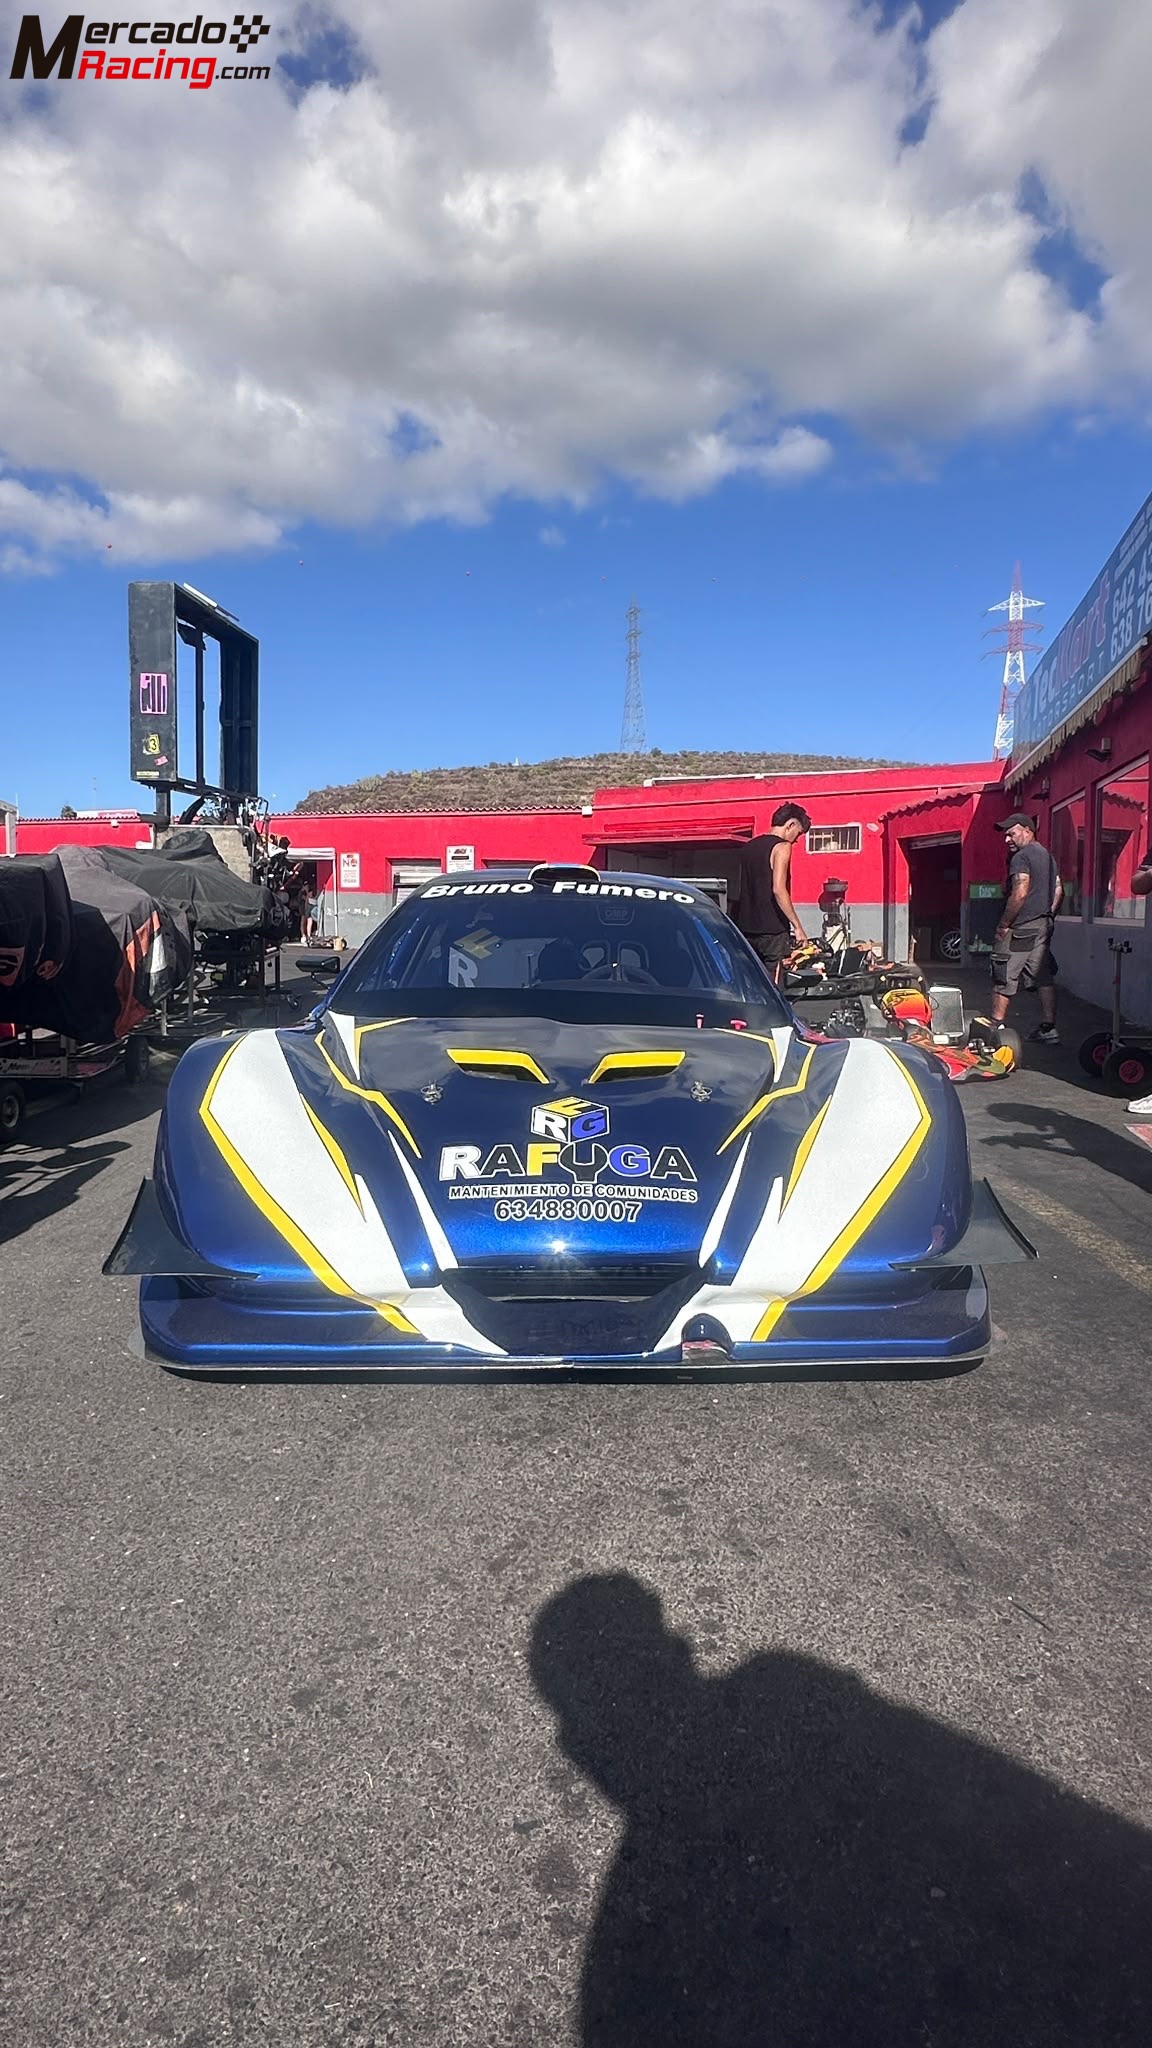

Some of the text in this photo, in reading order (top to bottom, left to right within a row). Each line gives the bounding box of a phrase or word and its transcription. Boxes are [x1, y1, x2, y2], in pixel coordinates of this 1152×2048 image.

[1113, 568, 1136, 624] 642
[1111, 609, 1133, 662] 638
[421, 881, 695, 904] Bruno Fumero
[449, 1184, 698, 1203] MANTENIMIENTO DE COMUNIDADES
[495, 1200, 642, 1222] 634880007
